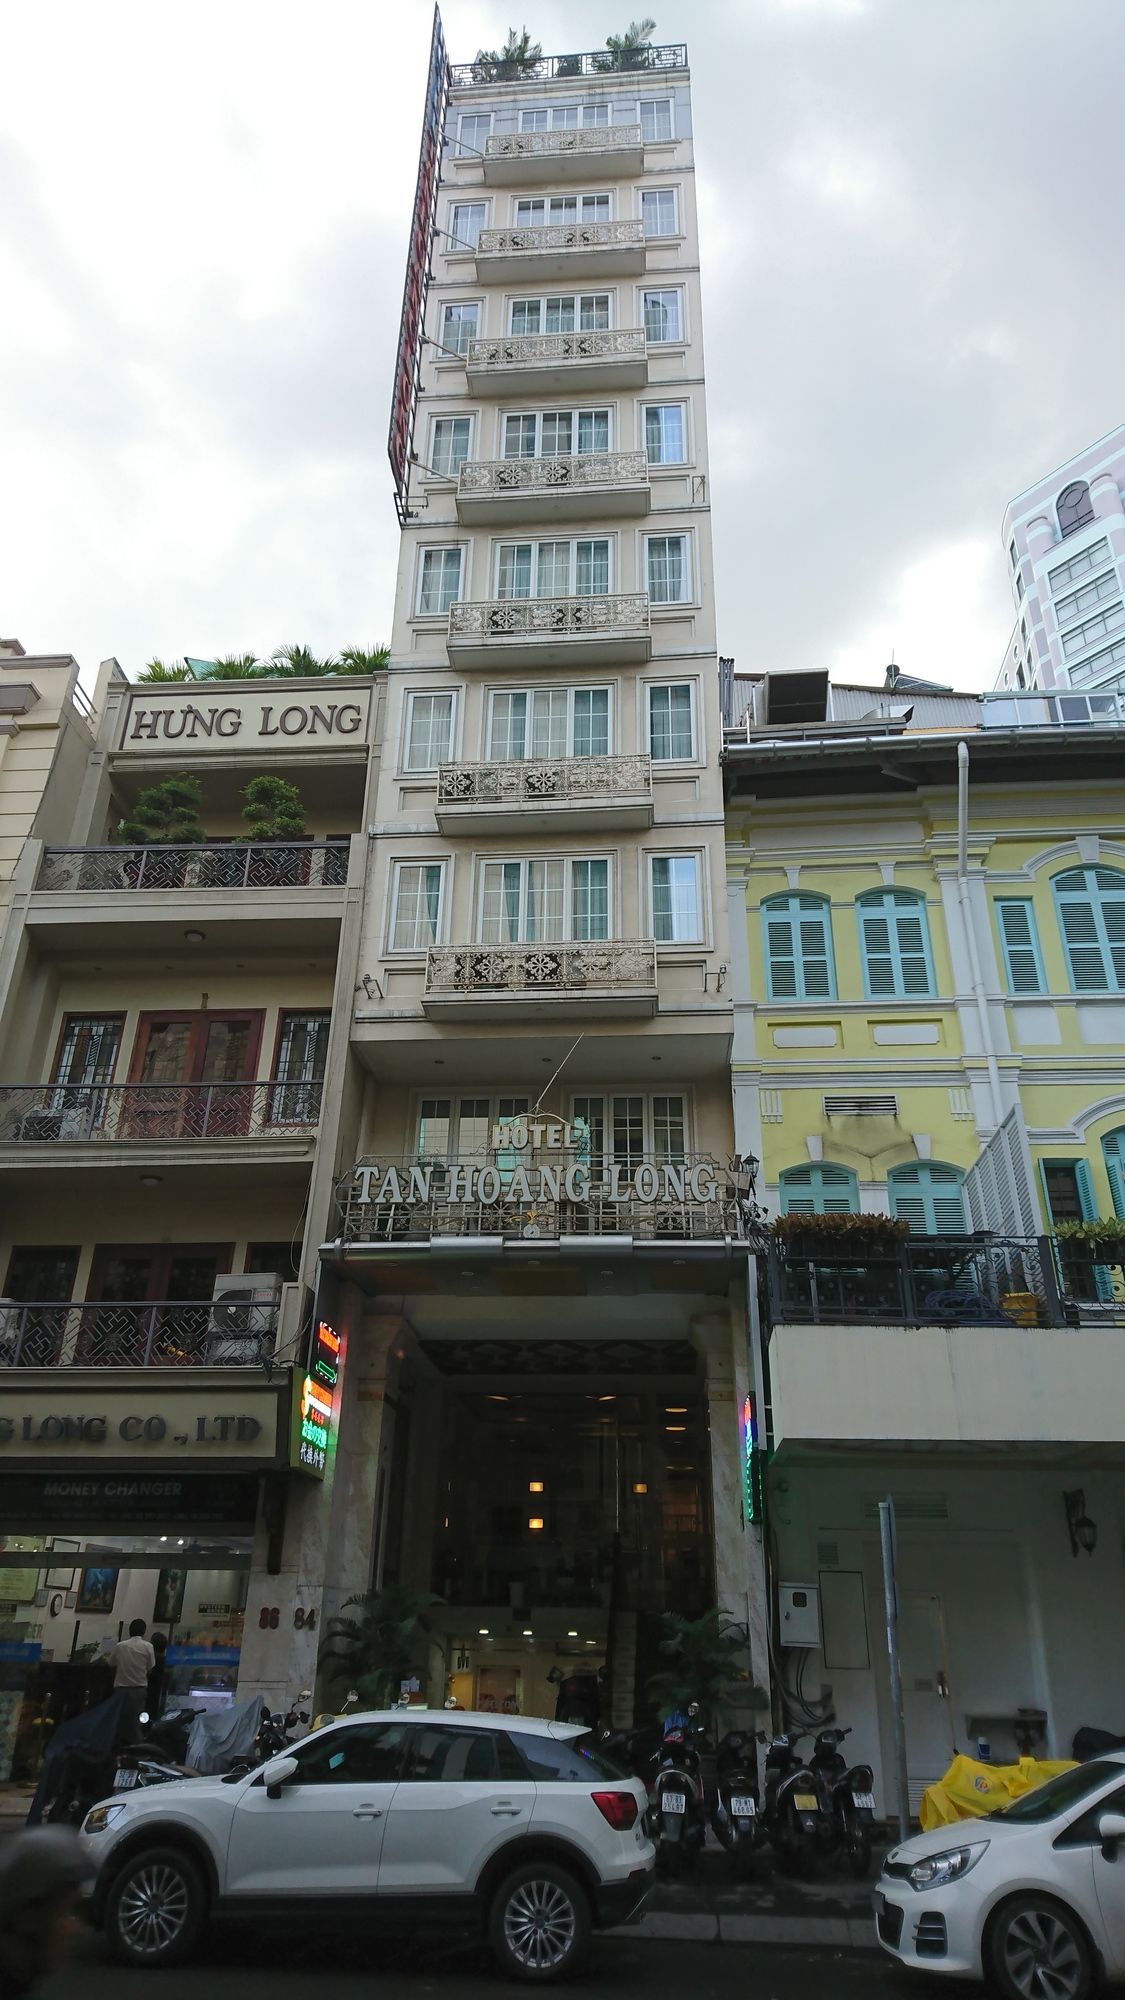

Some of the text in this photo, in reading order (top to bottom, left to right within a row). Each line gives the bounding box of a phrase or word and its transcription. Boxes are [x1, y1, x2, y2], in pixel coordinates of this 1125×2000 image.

[258, 704, 362, 736] LONG
[492, 1123, 579, 1150] HOTEL
[354, 1163, 719, 1204] TAN HOANG LONG
[22, 1415, 107, 1442] LONG
[44, 1481, 183, 1496] MONEY CHANGER
[294, 1607, 316, 1631] 84
